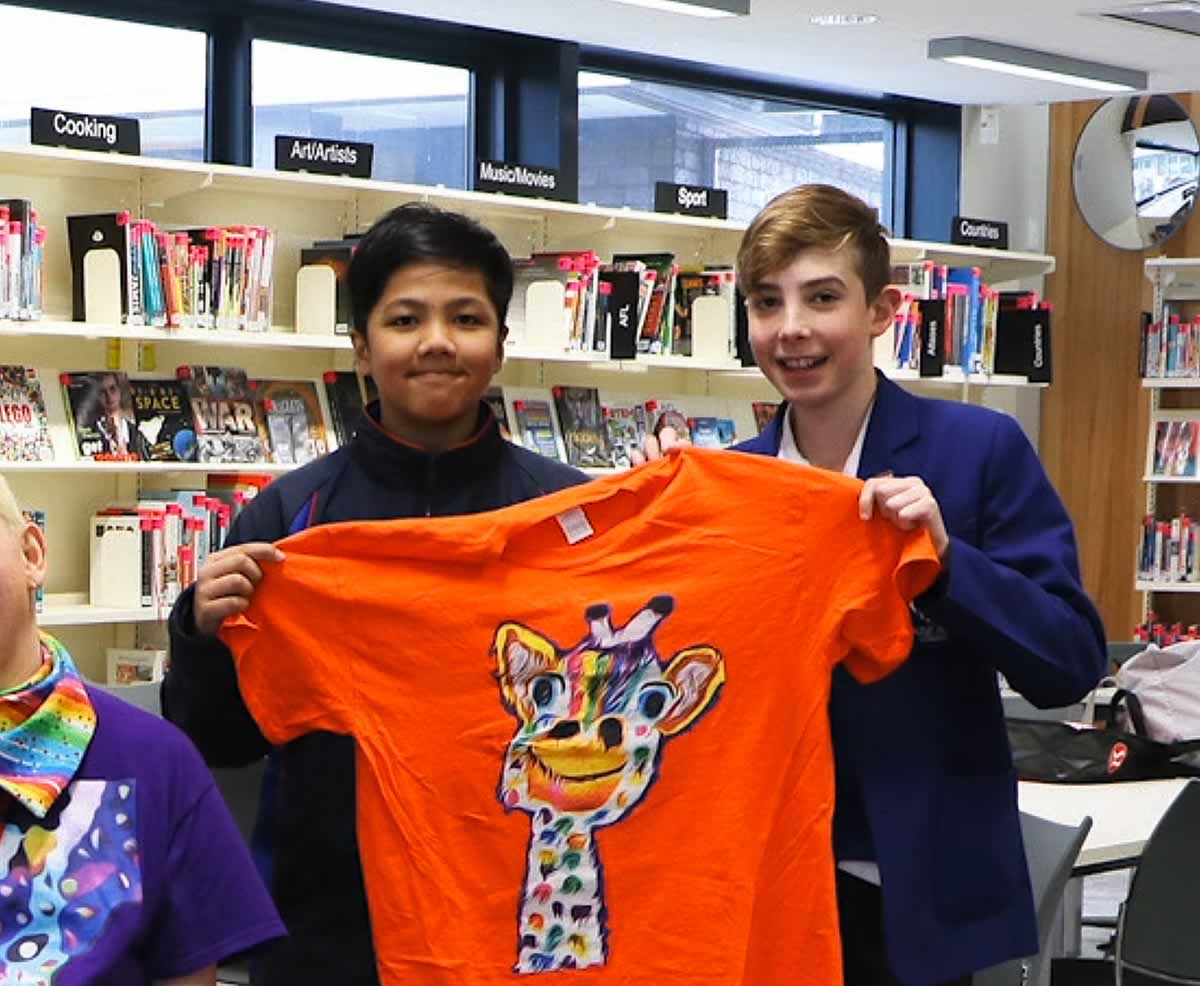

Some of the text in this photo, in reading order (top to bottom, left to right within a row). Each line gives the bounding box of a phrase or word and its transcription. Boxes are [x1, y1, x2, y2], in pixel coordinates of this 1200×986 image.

[53, 112, 117, 143] Cooking
[290, 140, 357, 165] Art/Artists
[479, 161, 556, 189] Music/Movies
[677, 187, 708, 209] Sport
[959, 219, 1000, 241] Countries
[618, 303, 630, 328] AFL
[1032, 323, 1044, 369] Countries
[135, 396, 181, 410] SPACE
[192, 400, 256, 433] WAR
